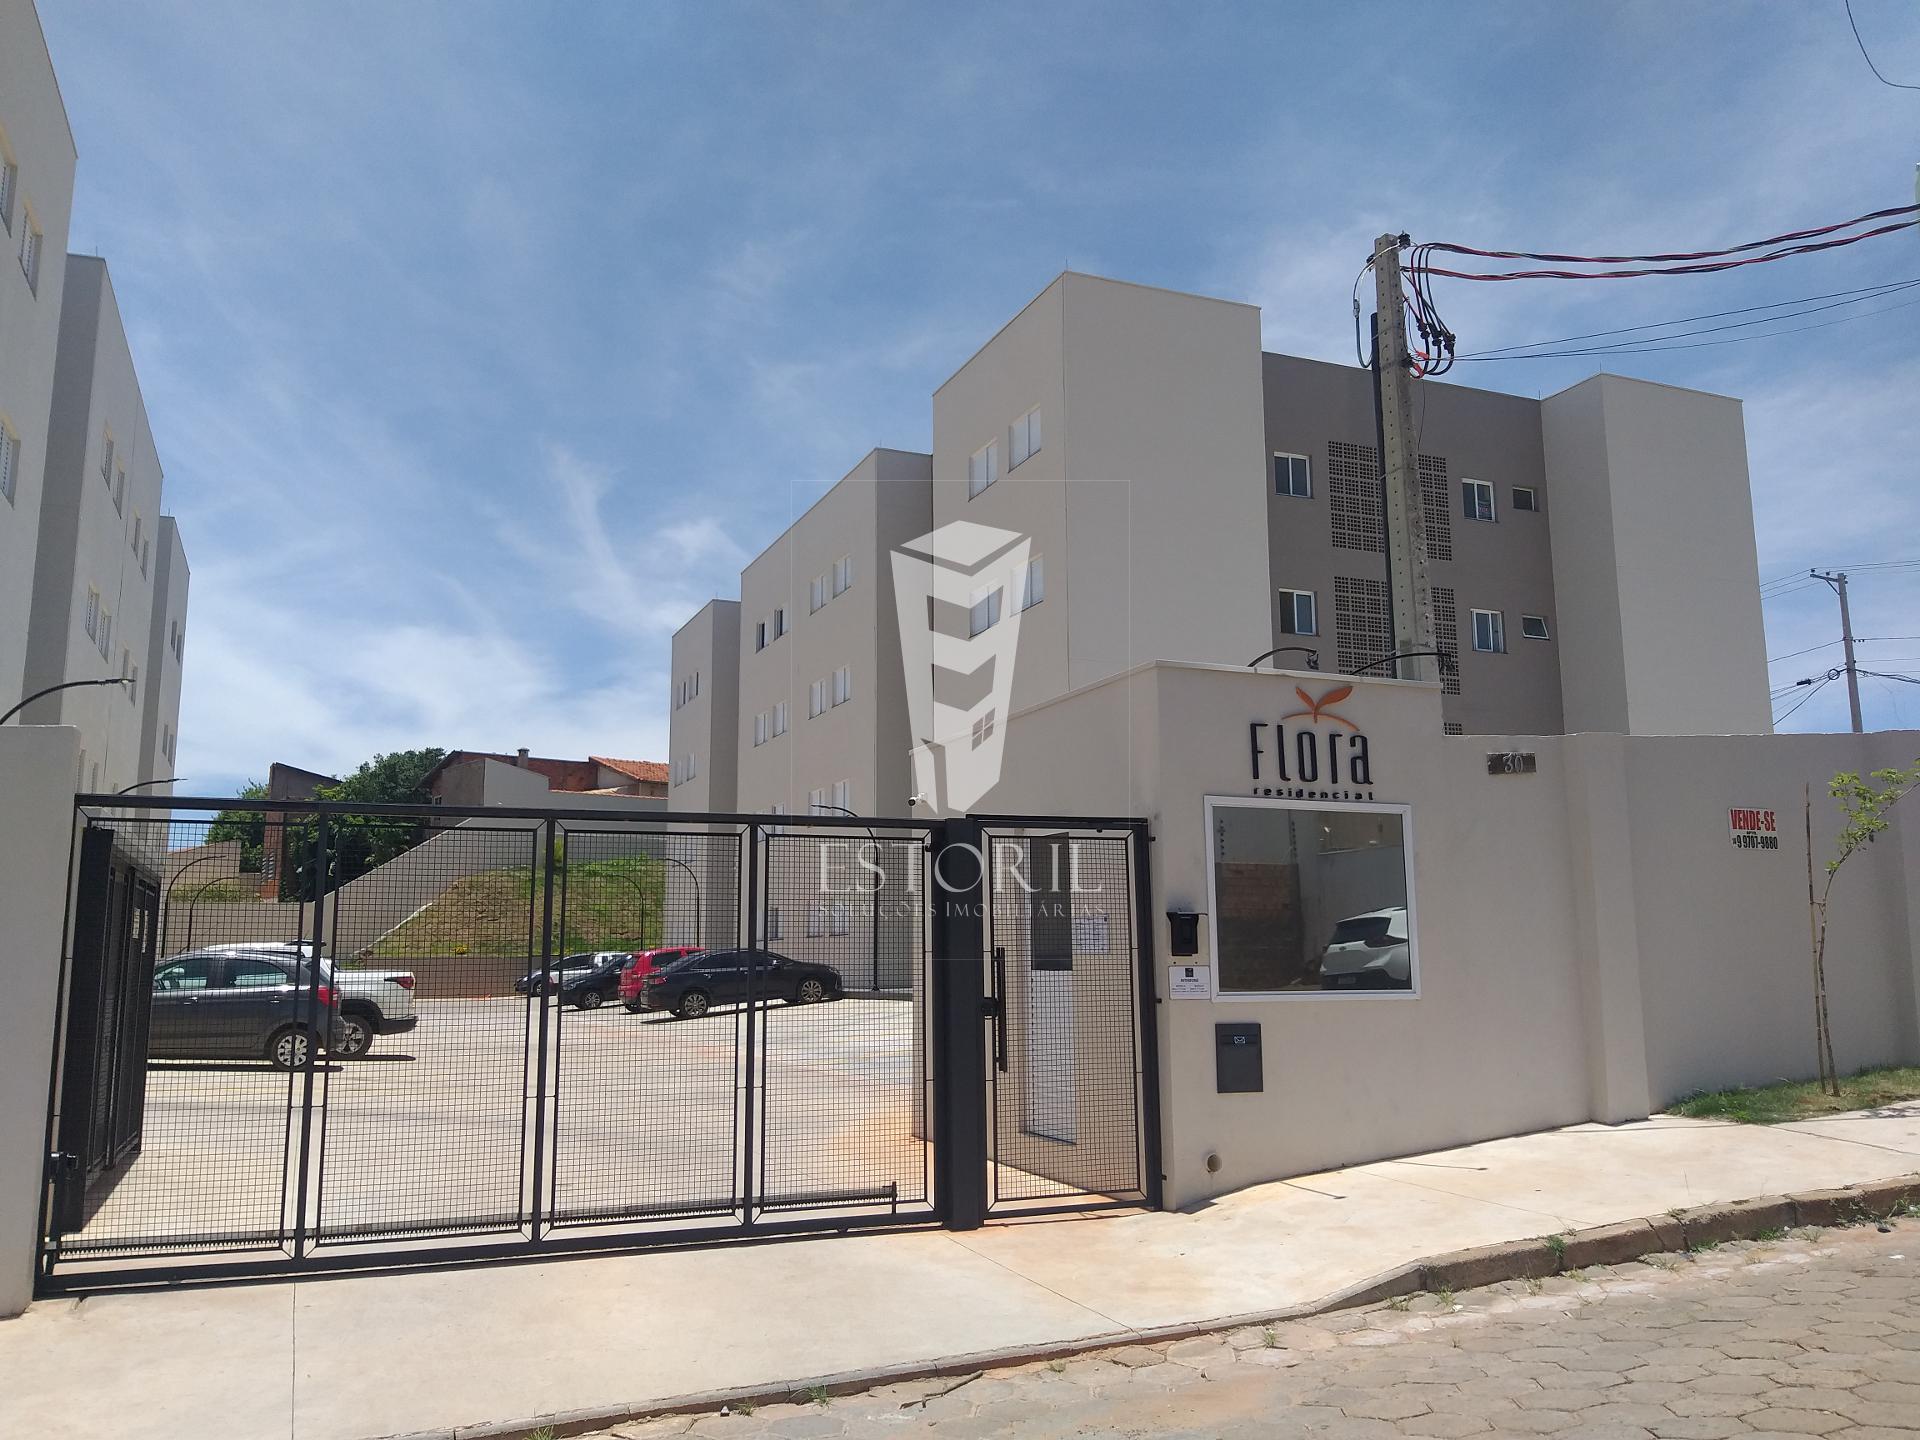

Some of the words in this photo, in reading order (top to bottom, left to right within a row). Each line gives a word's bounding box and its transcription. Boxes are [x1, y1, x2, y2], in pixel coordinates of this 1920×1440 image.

[1250, 723, 1374, 785] Flora
[1253, 787, 1374, 801] residencial
[1730, 809, 1776, 831] VENDE-SE
